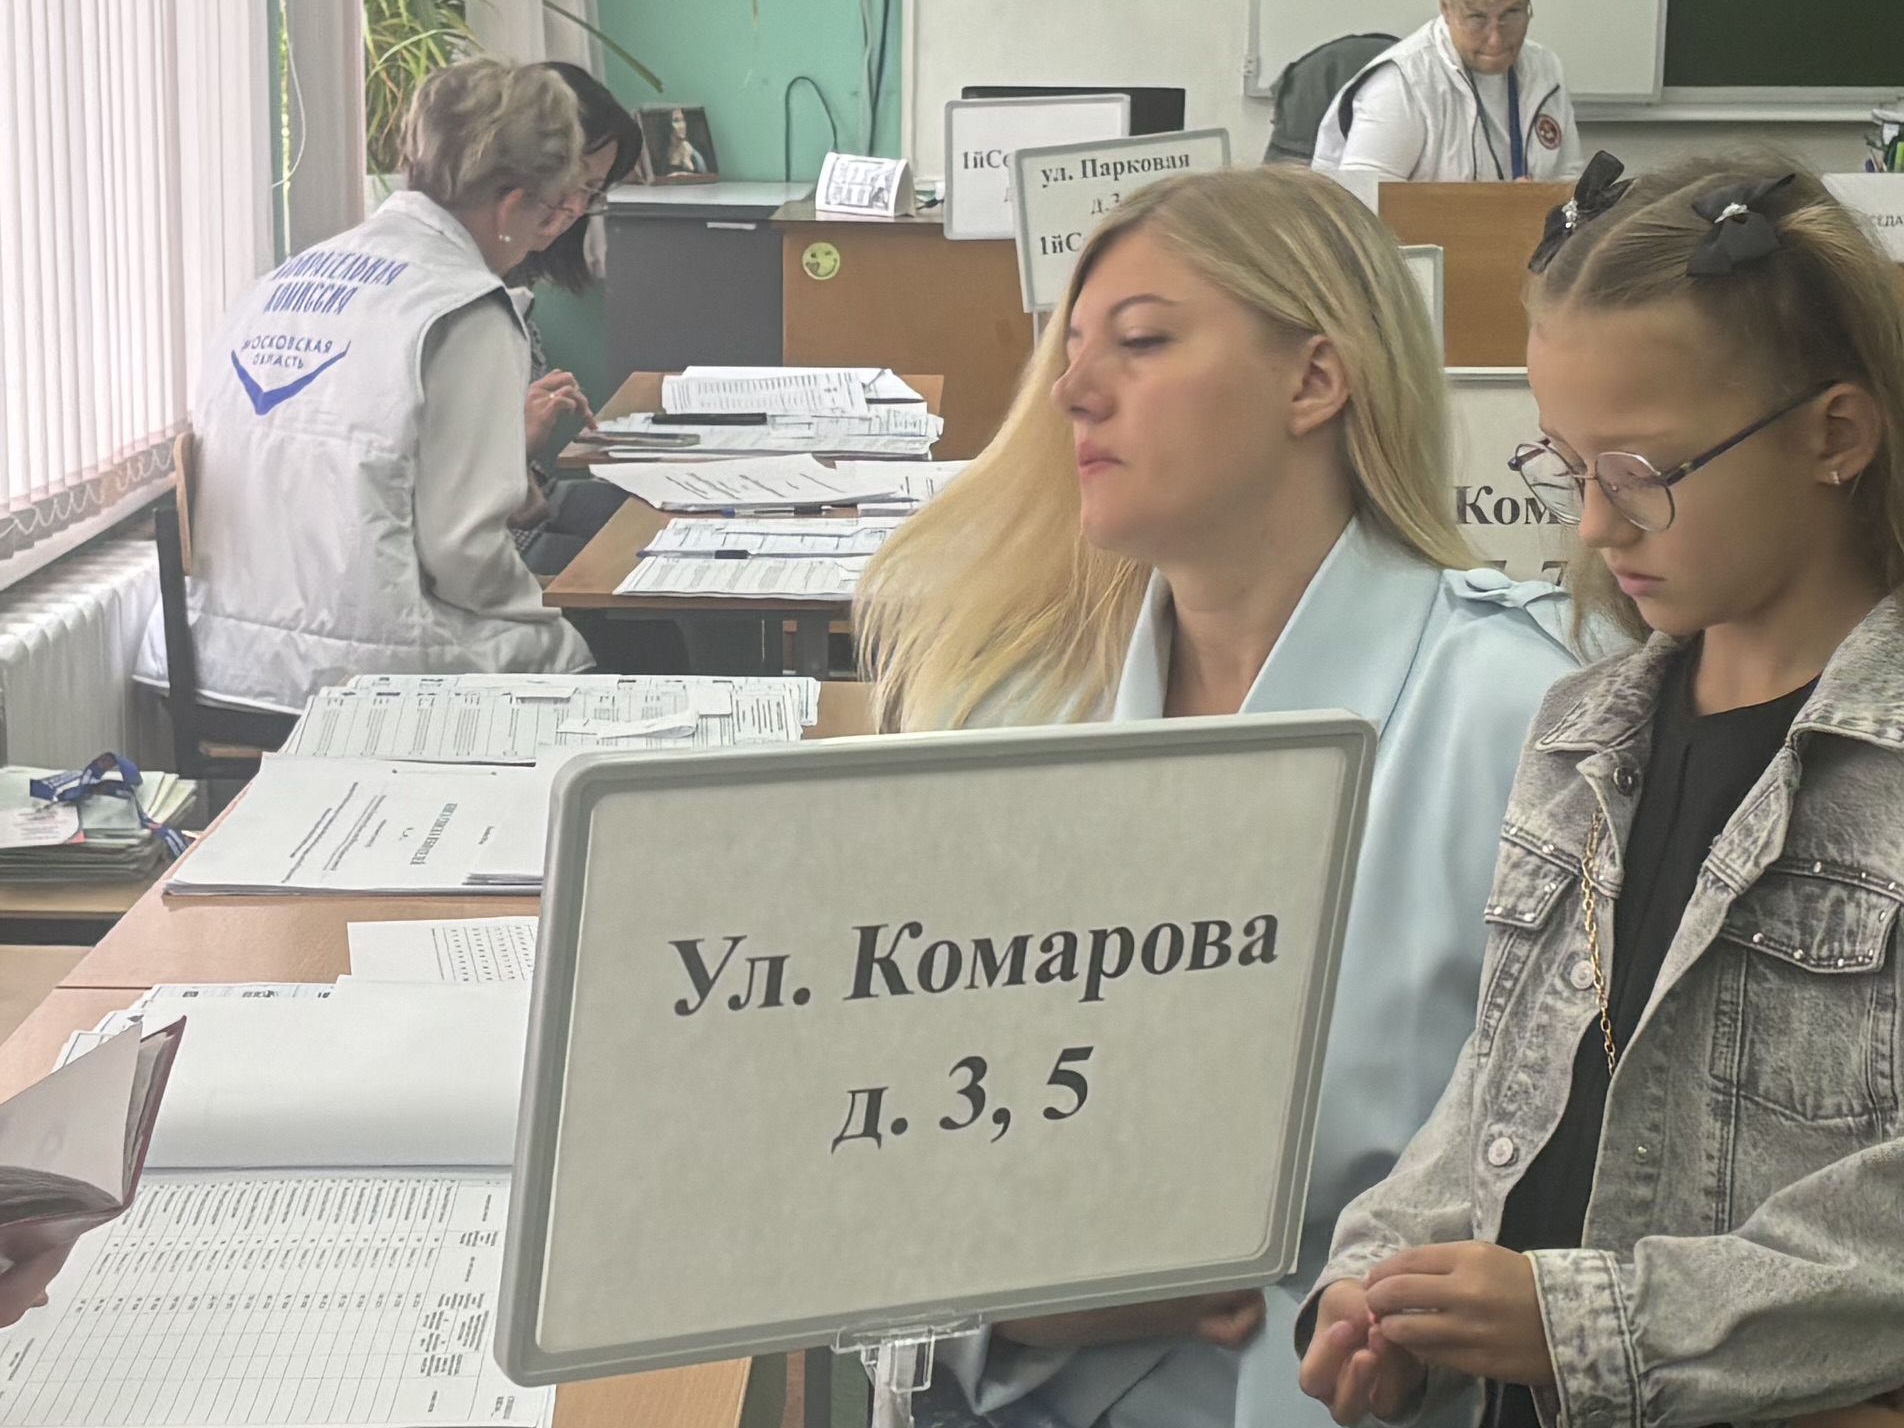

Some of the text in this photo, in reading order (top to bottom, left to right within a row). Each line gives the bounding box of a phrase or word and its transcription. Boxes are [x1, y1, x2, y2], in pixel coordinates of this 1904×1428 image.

[1040, 152, 1191, 188] ул. Парковая
[263, 281, 360, 316] КОМИССИЯ
[241, 334, 334, 353] МОСКОВСКАЯ
[668, 913, 1279, 1017] Ул. Комарова
[831, 1045, 1095, 1154] д. 3, 5
